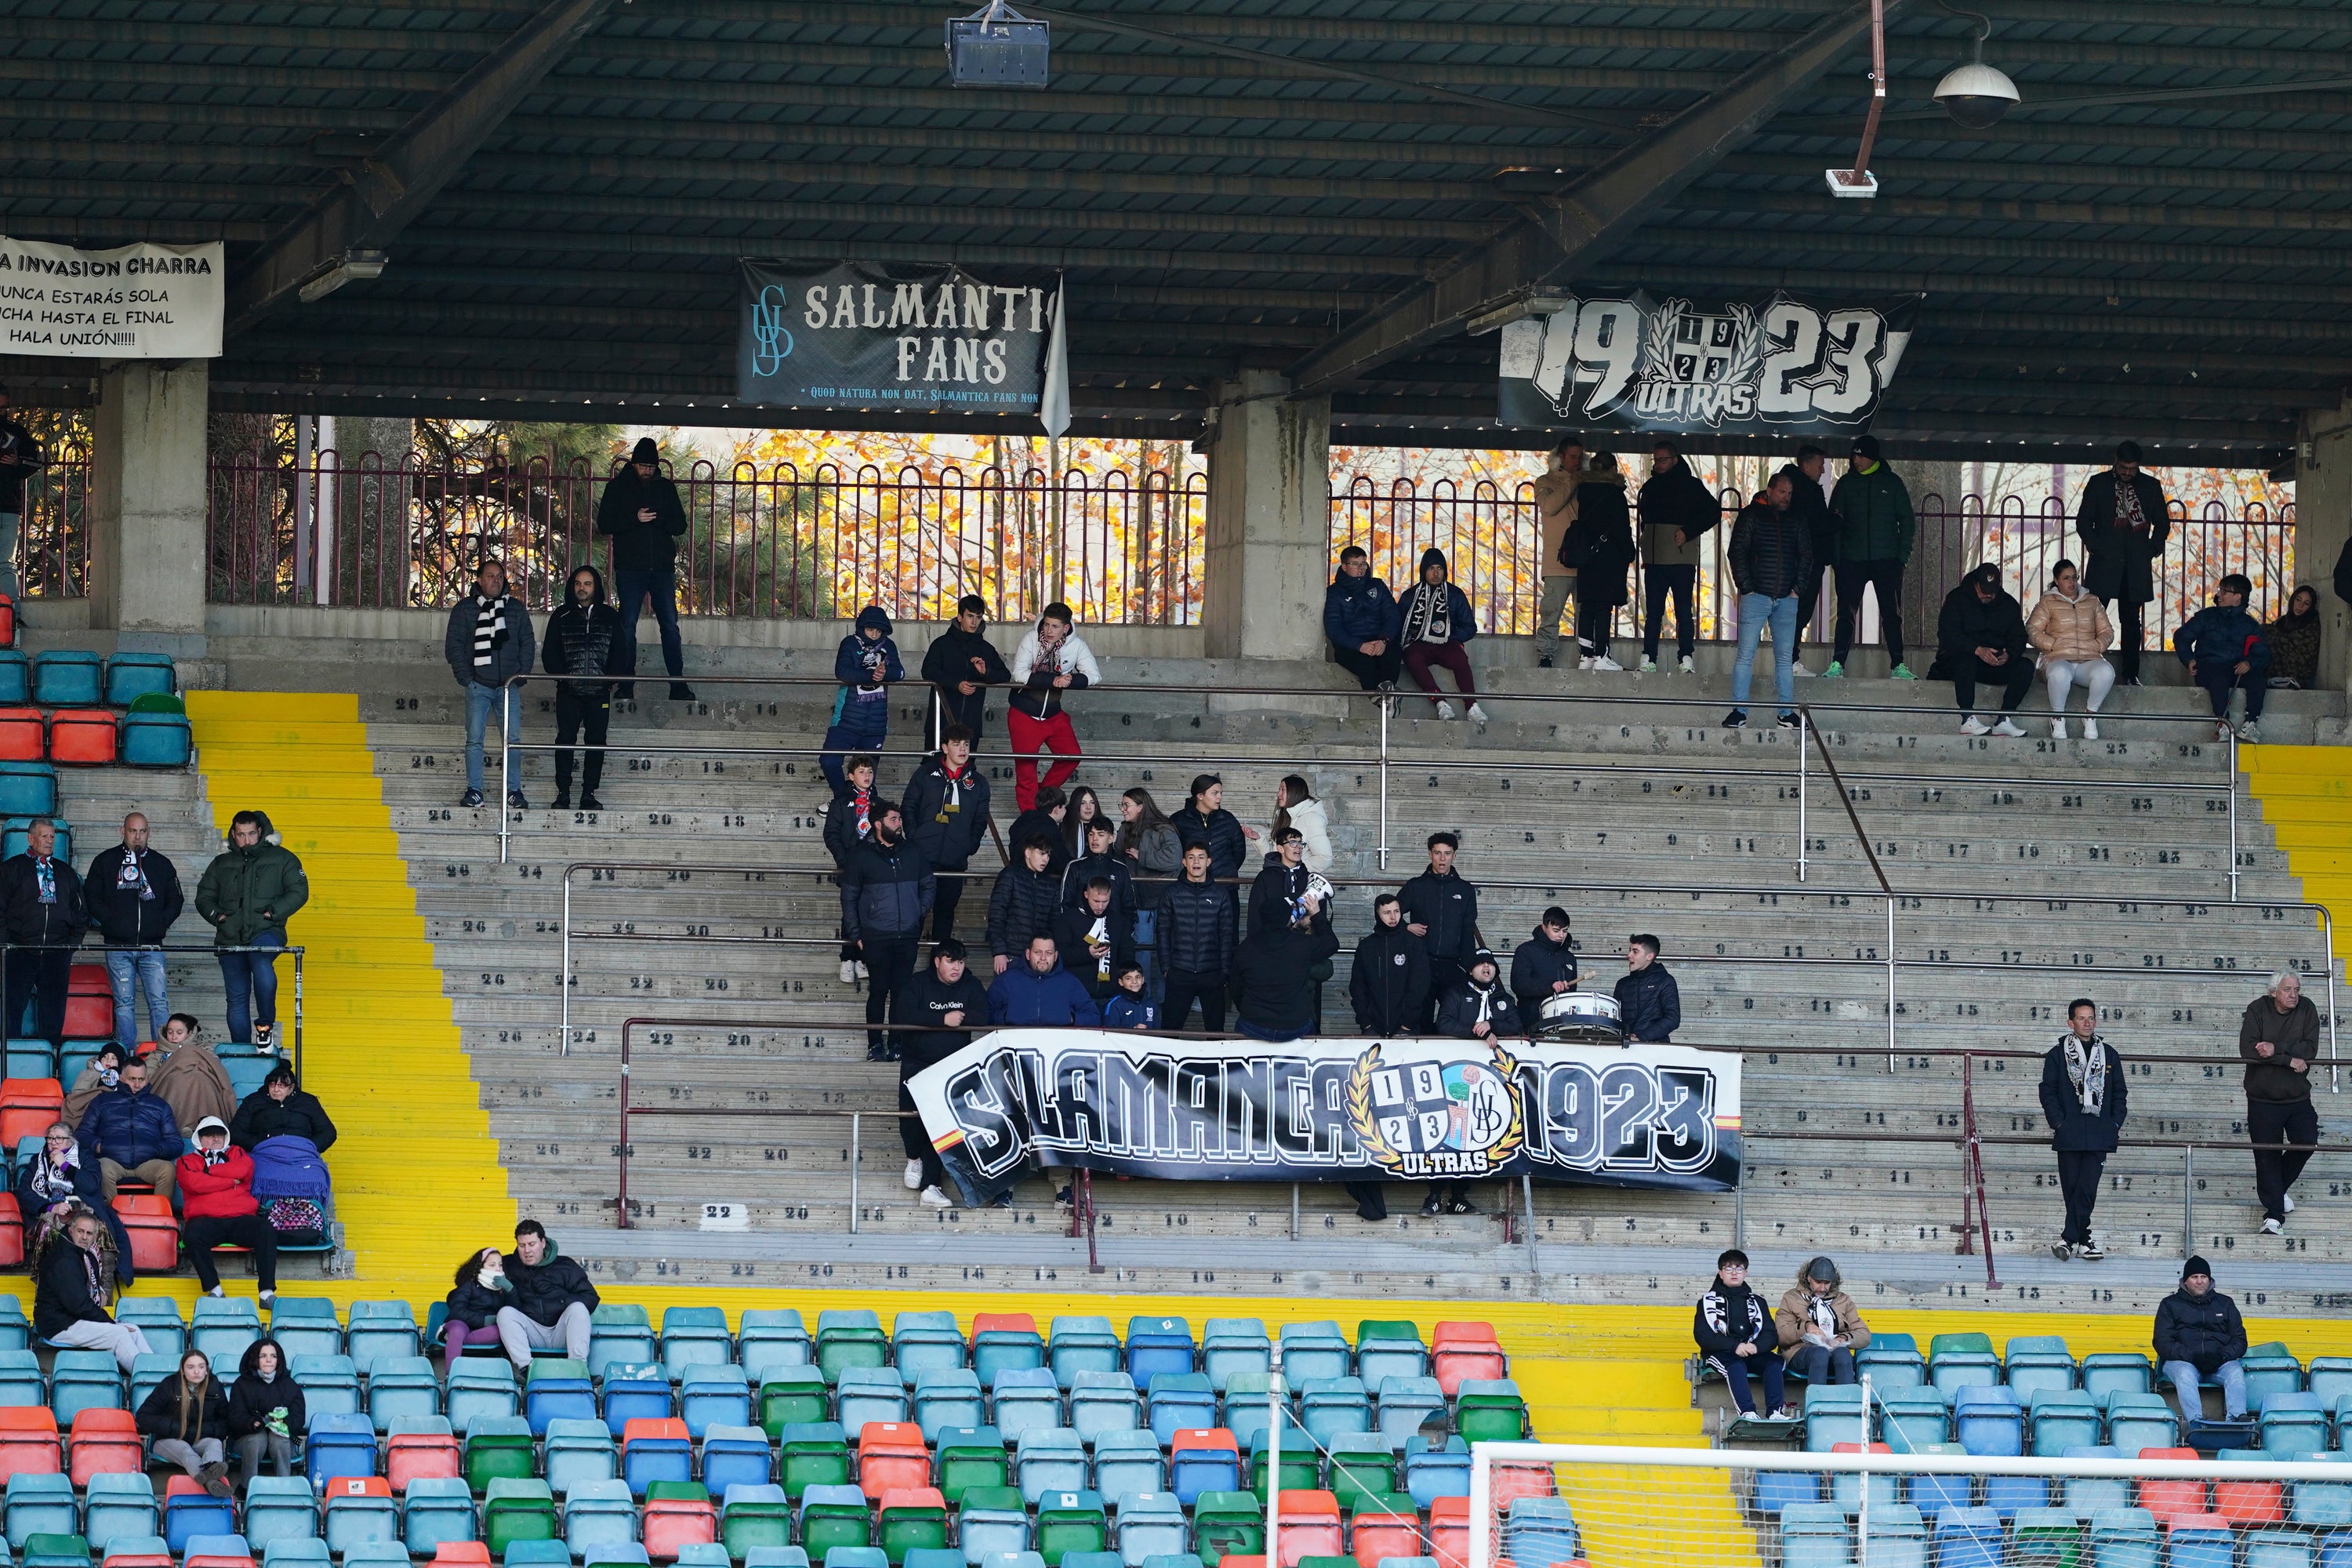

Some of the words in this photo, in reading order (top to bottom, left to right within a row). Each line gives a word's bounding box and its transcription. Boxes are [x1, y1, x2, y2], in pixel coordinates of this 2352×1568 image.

[17, 256, 121, 278] INVASION
[125, 257, 212, 274] CHARRA
[0, 287, 44, 301] UNCA
[52, 288, 123, 304] ESTARÁS
[129, 290, 169, 303] SOLA
[41, 310, 96, 324] HASTA
[103, 313, 119, 325] EL
[125, 311, 174, 324] FINAL
[9, 329, 52, 343] HALA
[895, 336, 1007, 384] FANS
[1635, 381, 1758, 425] ULTRAS
[757, 704, 777, 716] 16
[1548, 725, 1556, 736] 7
[1686, 729, 1704, 742] 11
[1896, 736, 1916, 748] 17
[1967, 739, 1987, 750] 19
[2037, 741, 2056, 753] 21
[2106, 743, 2127, 754] 23
[2179, 745, 2200, 756] 25
[412, 756, 434, 768] 26
[630, 760, 651, 771] 20
[774, 763, 795, 775] 16
[992, 767, 1013, 779] 10
[1573, 780, 1581, 791] 7
[1708, 786, 1727, 797] 11
[1779, 788, 1798, 798] 13
[1849, 789, 1871, 800] 15
[1922, 791, 1942, 802] 17
[1992, 793, 2013, 804] 19
[2063, 796, 2082, 808] 21
[2132, 798, 2153, 810] 23
[2206, 801, 2227, 811] 25
[429, 810, 451, 821] 26
[575, 812, 597, 824] 22
[794, 817, 815, 829] 16
[1597, 833, 1606, 844] 7
[1735, 838, 1754, 851] 11
[1806, 839, 1825, 851] 13
[1876, 842, 1896, 855] 15
[1947, 844, 1969, 857] 17
[2018, 846, 2038, 857] 19
[2089, 848, 2109, 859] 21
[519, 866, 541, 879] 24
[1829, 896, 1849, 906] 13
[2118, 903, 2138, 913] 21
[2186, 905, 2208, 915] 23
[2262, 908, 2283, 920] 25
[463, 920, 485, 932] 26
[535, 921, 559, 933] 24
[686, 925, 709, 936] 20
[762, 927, 783, 938] 18
[1784, 946, 1802, 957] 11
[1855, 948, 1876, 959] 13
[1928, 950, 1949, 961] 15
[2001, 951, 2022, 963] 17
[2072, 953, 2092, 964] 19
[2143, 956, 2163, 967] 21
[2214, 957, 2236, 968] 23
[2289, 959, 2310, 970] 25
[481, 974, 504, 985] 26
[630, 978, 652, 989] 22
[1811, 1000, 1831, 1012] 11
[1957, 1004, 1978, 1015] 15
[2030, 1007, 2050, 1018] 17
[2102, 1008, 2122, 1019] 19
[2172, 1011, 2193, 1021] 21
[499, 1031, 521, 1043] 26
[573, 1032, 596, 1043] 24
[651, 1033, 673, 1045] 22
[728, 1035, 750, 1045] 20
[1837, 1055, 1856, 1067] 11
[1907, 1058, 1929, 1069] 13
[1983, 1060, 2005, 1071] 15
[2130, 1064, 2151, 1076] 19
[2203, 1065, 2223, 1077] 21
[1515, 1060, 1717, 1174] 1923
[1864, 1112, 1884, 1124] 11
[1936, 1114, 1958, 1126] 13
[2159, 1121, 2179, 1132] 19
[688, 1147, 711, 1159] 22
[764, 1149, 789, 1160] 20
[1402, 1152, 1489, 1174] ULTRAS
[1748, 1167, 1755, 1178] 7
[1890, 1171, 1910, 1183] 11
[2329, 1183, 2351, 1195] 23
[707, 1206, 730, 1218] 22
[785, 1208, 808, 1219] 20
[1013, 1212, 1035, 1223] 14
[1776, 1224, 1784, 1236] 7
[1919, 1227, 1937, 1239] 11
[1994, 1230, 2014, 1242] 13
[2140, 1234, 2161, 1246] 17
[2286, 1240, 2306, 1251] 21
[731, 1264, 754, 1276] 22
[810, 1265, 833, 1276] 20
[887, 1267, 908, 1278] 18
[1117, 1270, 1136, 1281] 12
[1193, 1271, 1214, 1283] 10
[1947, 1286, 1966, 1297] 11
[2018, 1287, 2039, 1299] 13
[2091, 1289, 2112, 1301] 15
[2245, 1293, 2266, 1305] 19
[2314, 1294, 2333, 1307] 21
